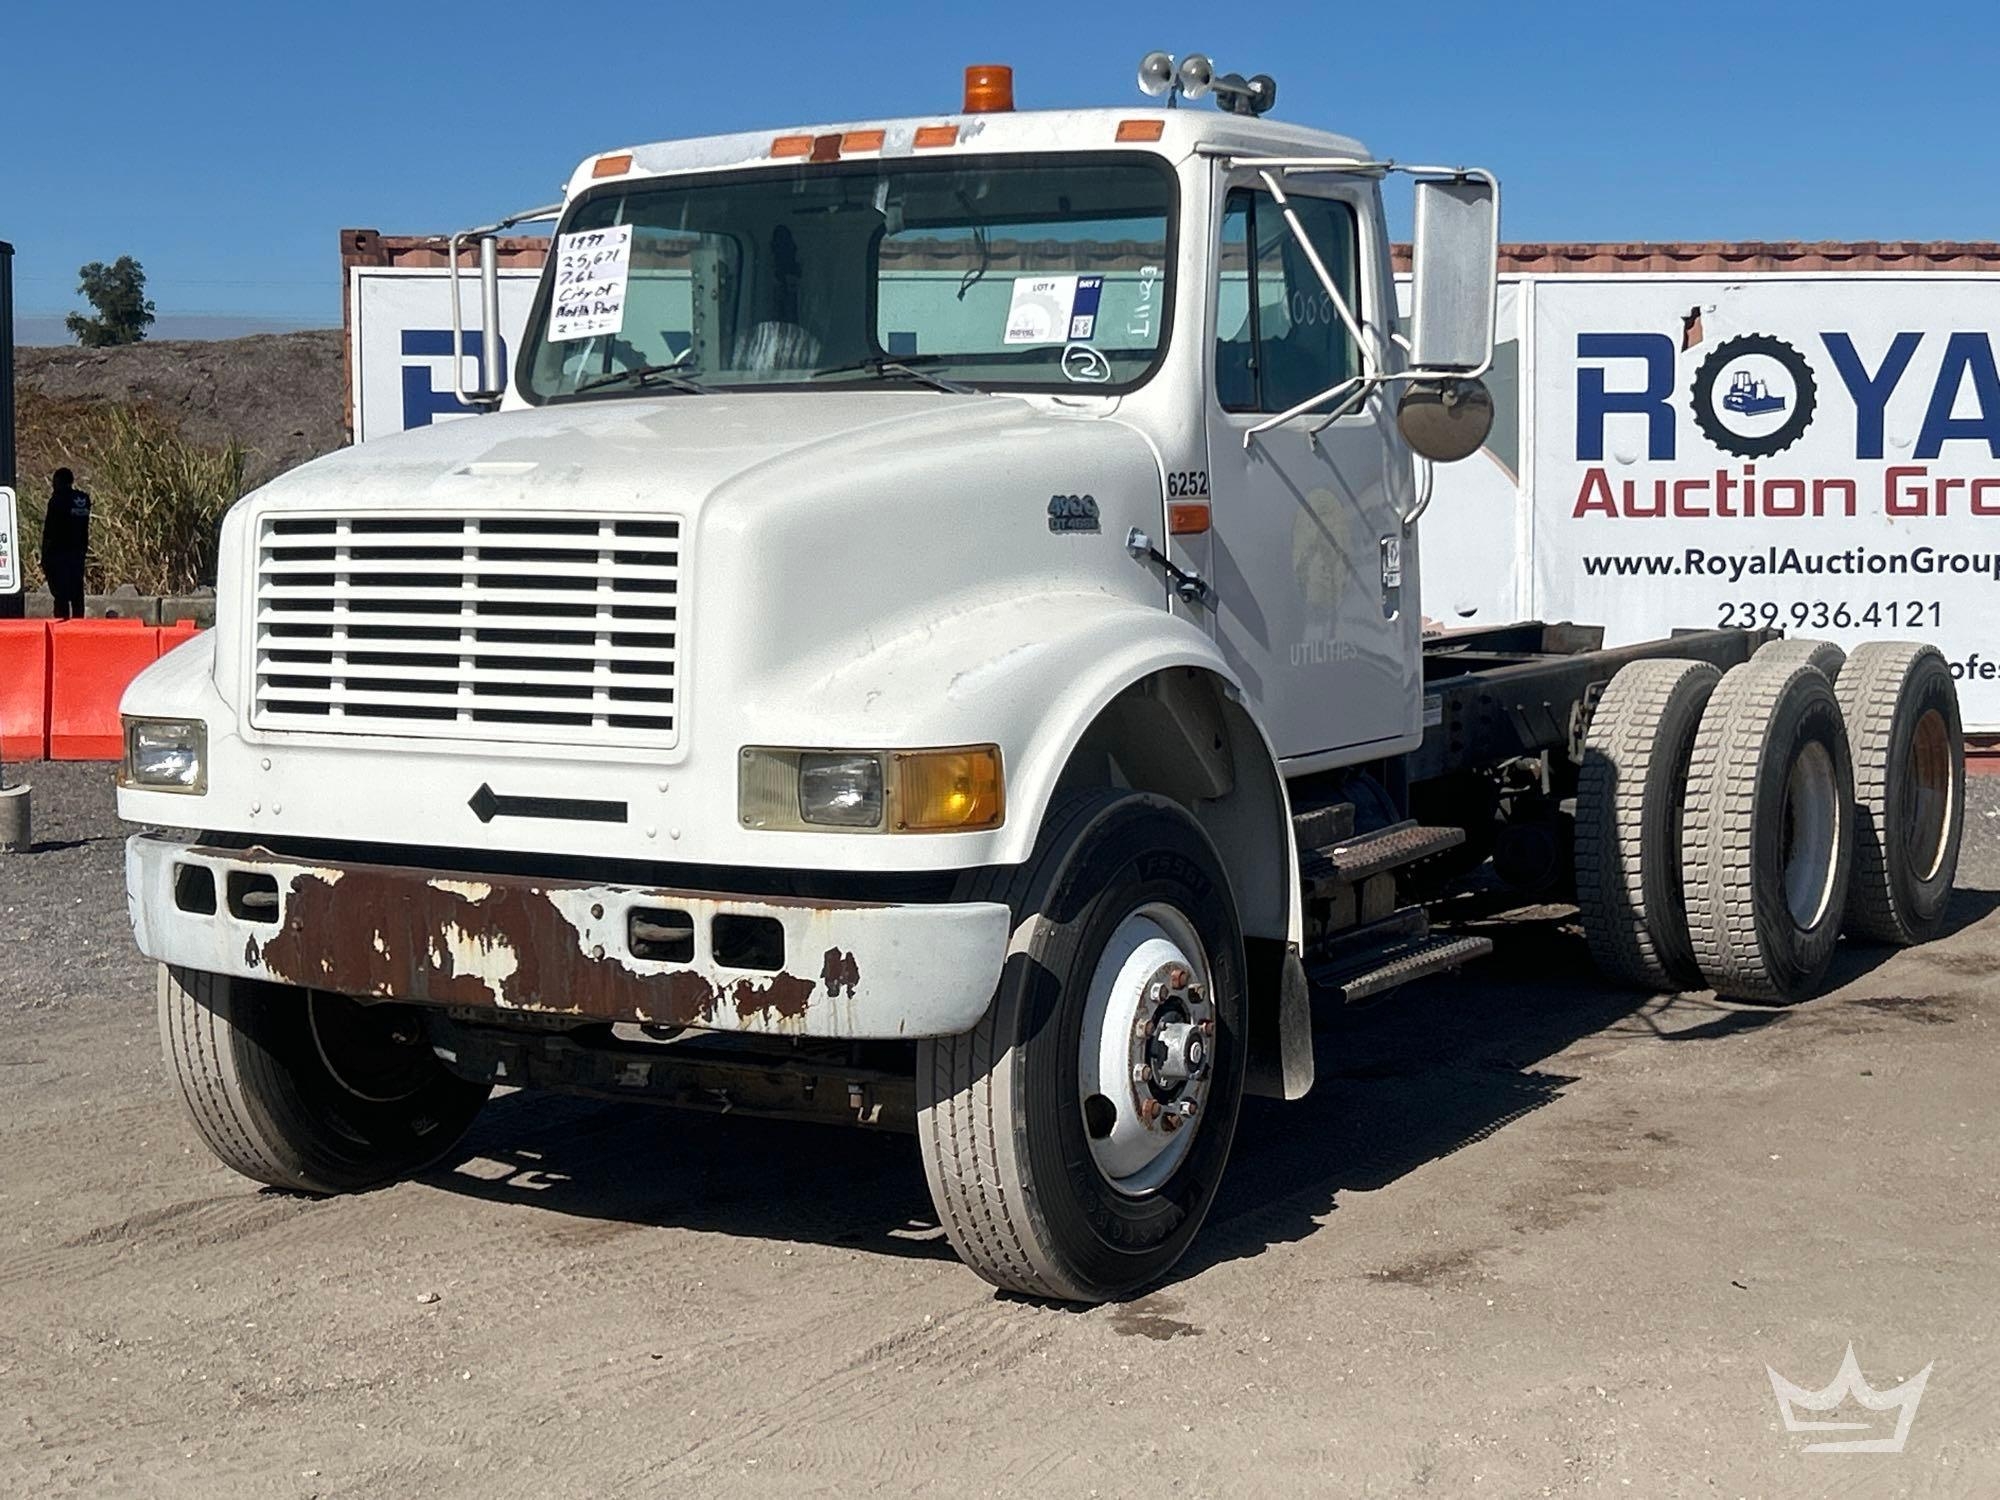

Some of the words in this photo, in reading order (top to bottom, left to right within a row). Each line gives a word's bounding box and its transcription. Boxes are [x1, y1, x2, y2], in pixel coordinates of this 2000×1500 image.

[562, 249, 620, 270] 25,671
[1032, 283, 1049, 292] LOT
[1071, 353, 1100, 376] 2
[1168, 471, 1207, 496] 6252
[1572, 464, 1857, 518] Auction
[1884, 465, 2000, 517] Gro
[1717, 601, 1941, 629] 239.936.4121
[1290, 640, 1358, 667] UTILITIES
